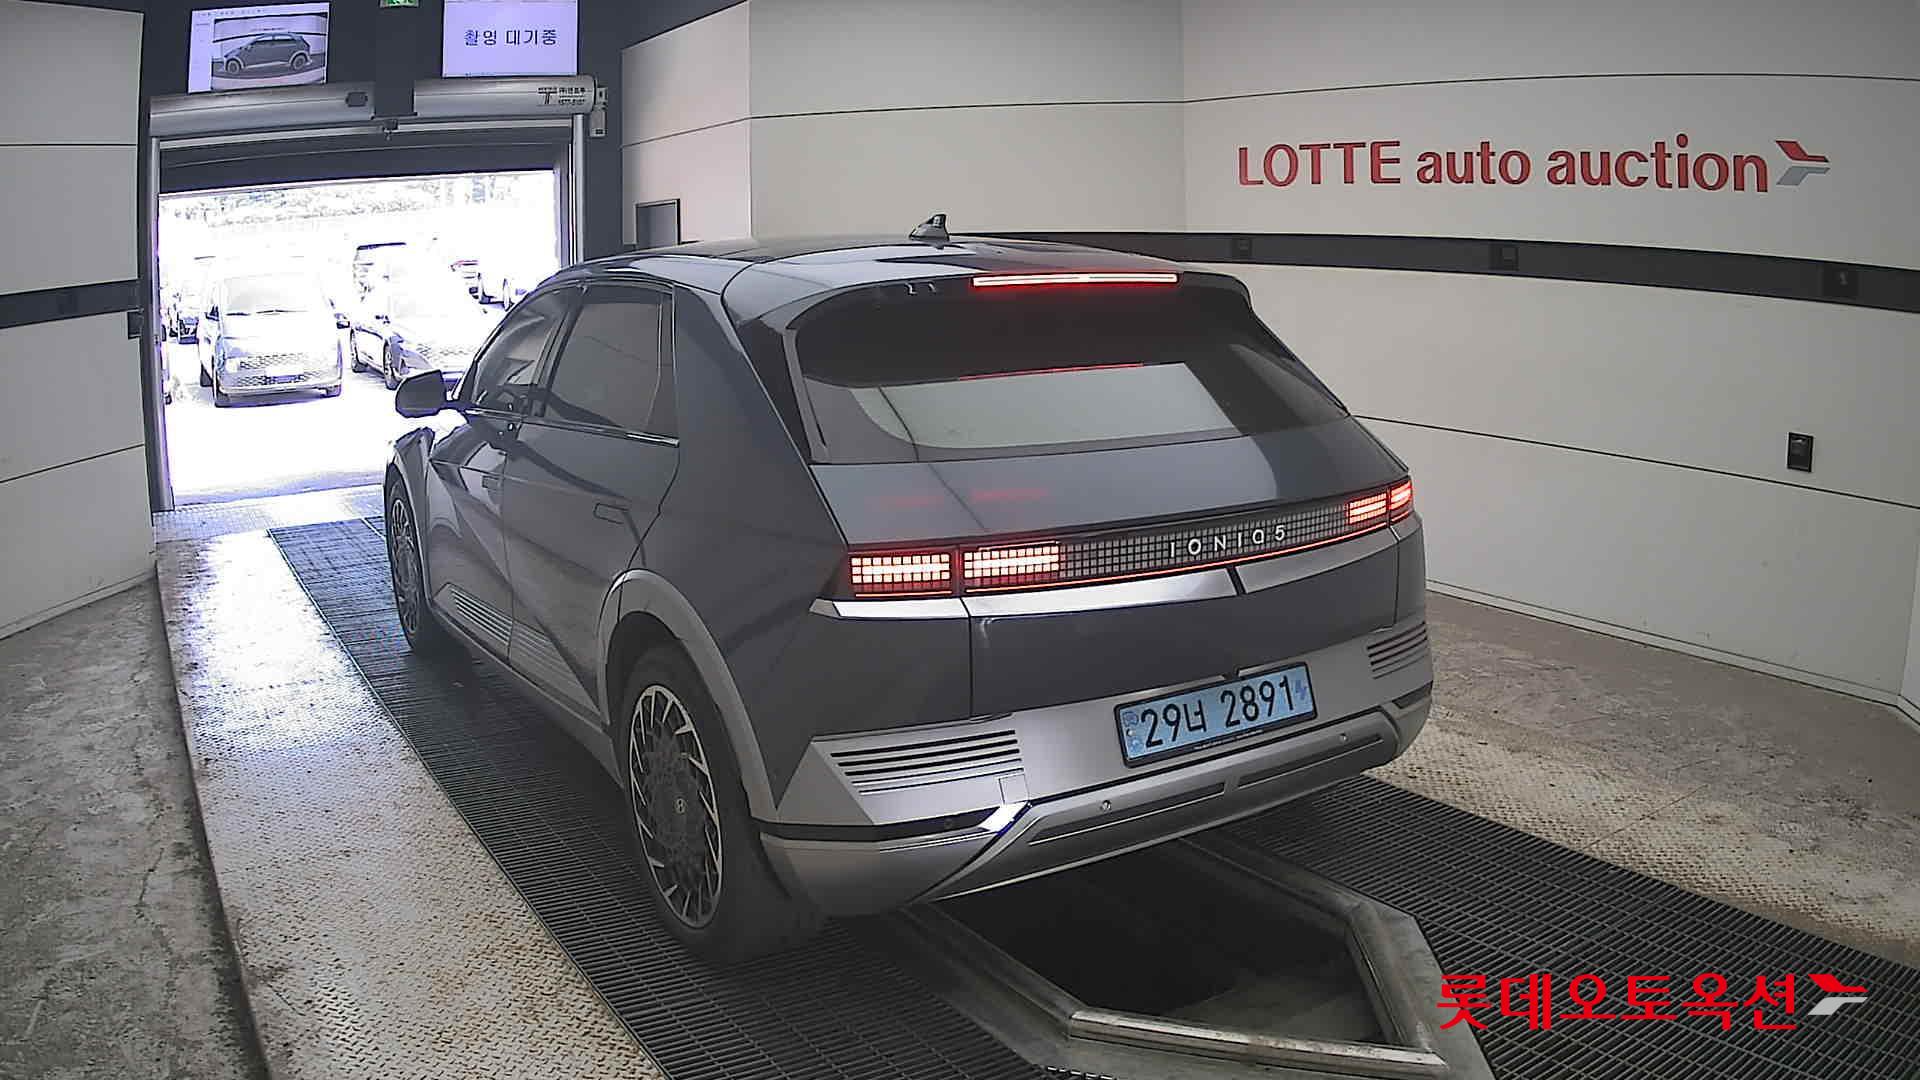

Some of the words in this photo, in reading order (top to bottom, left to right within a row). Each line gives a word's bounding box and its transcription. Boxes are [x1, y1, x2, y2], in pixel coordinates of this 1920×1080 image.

[464, 29, 497, 46] 촬영
[505, 29, 558, 46] 대기중
[1238, 140, 1400, 187] LOTTE
[1416, 141, 1532, 185] auto
[1546, 134, 1769, 192] auction
[1140, 700, 1207, 748] 29너
[1220, 675, 1294, 728] 2891
